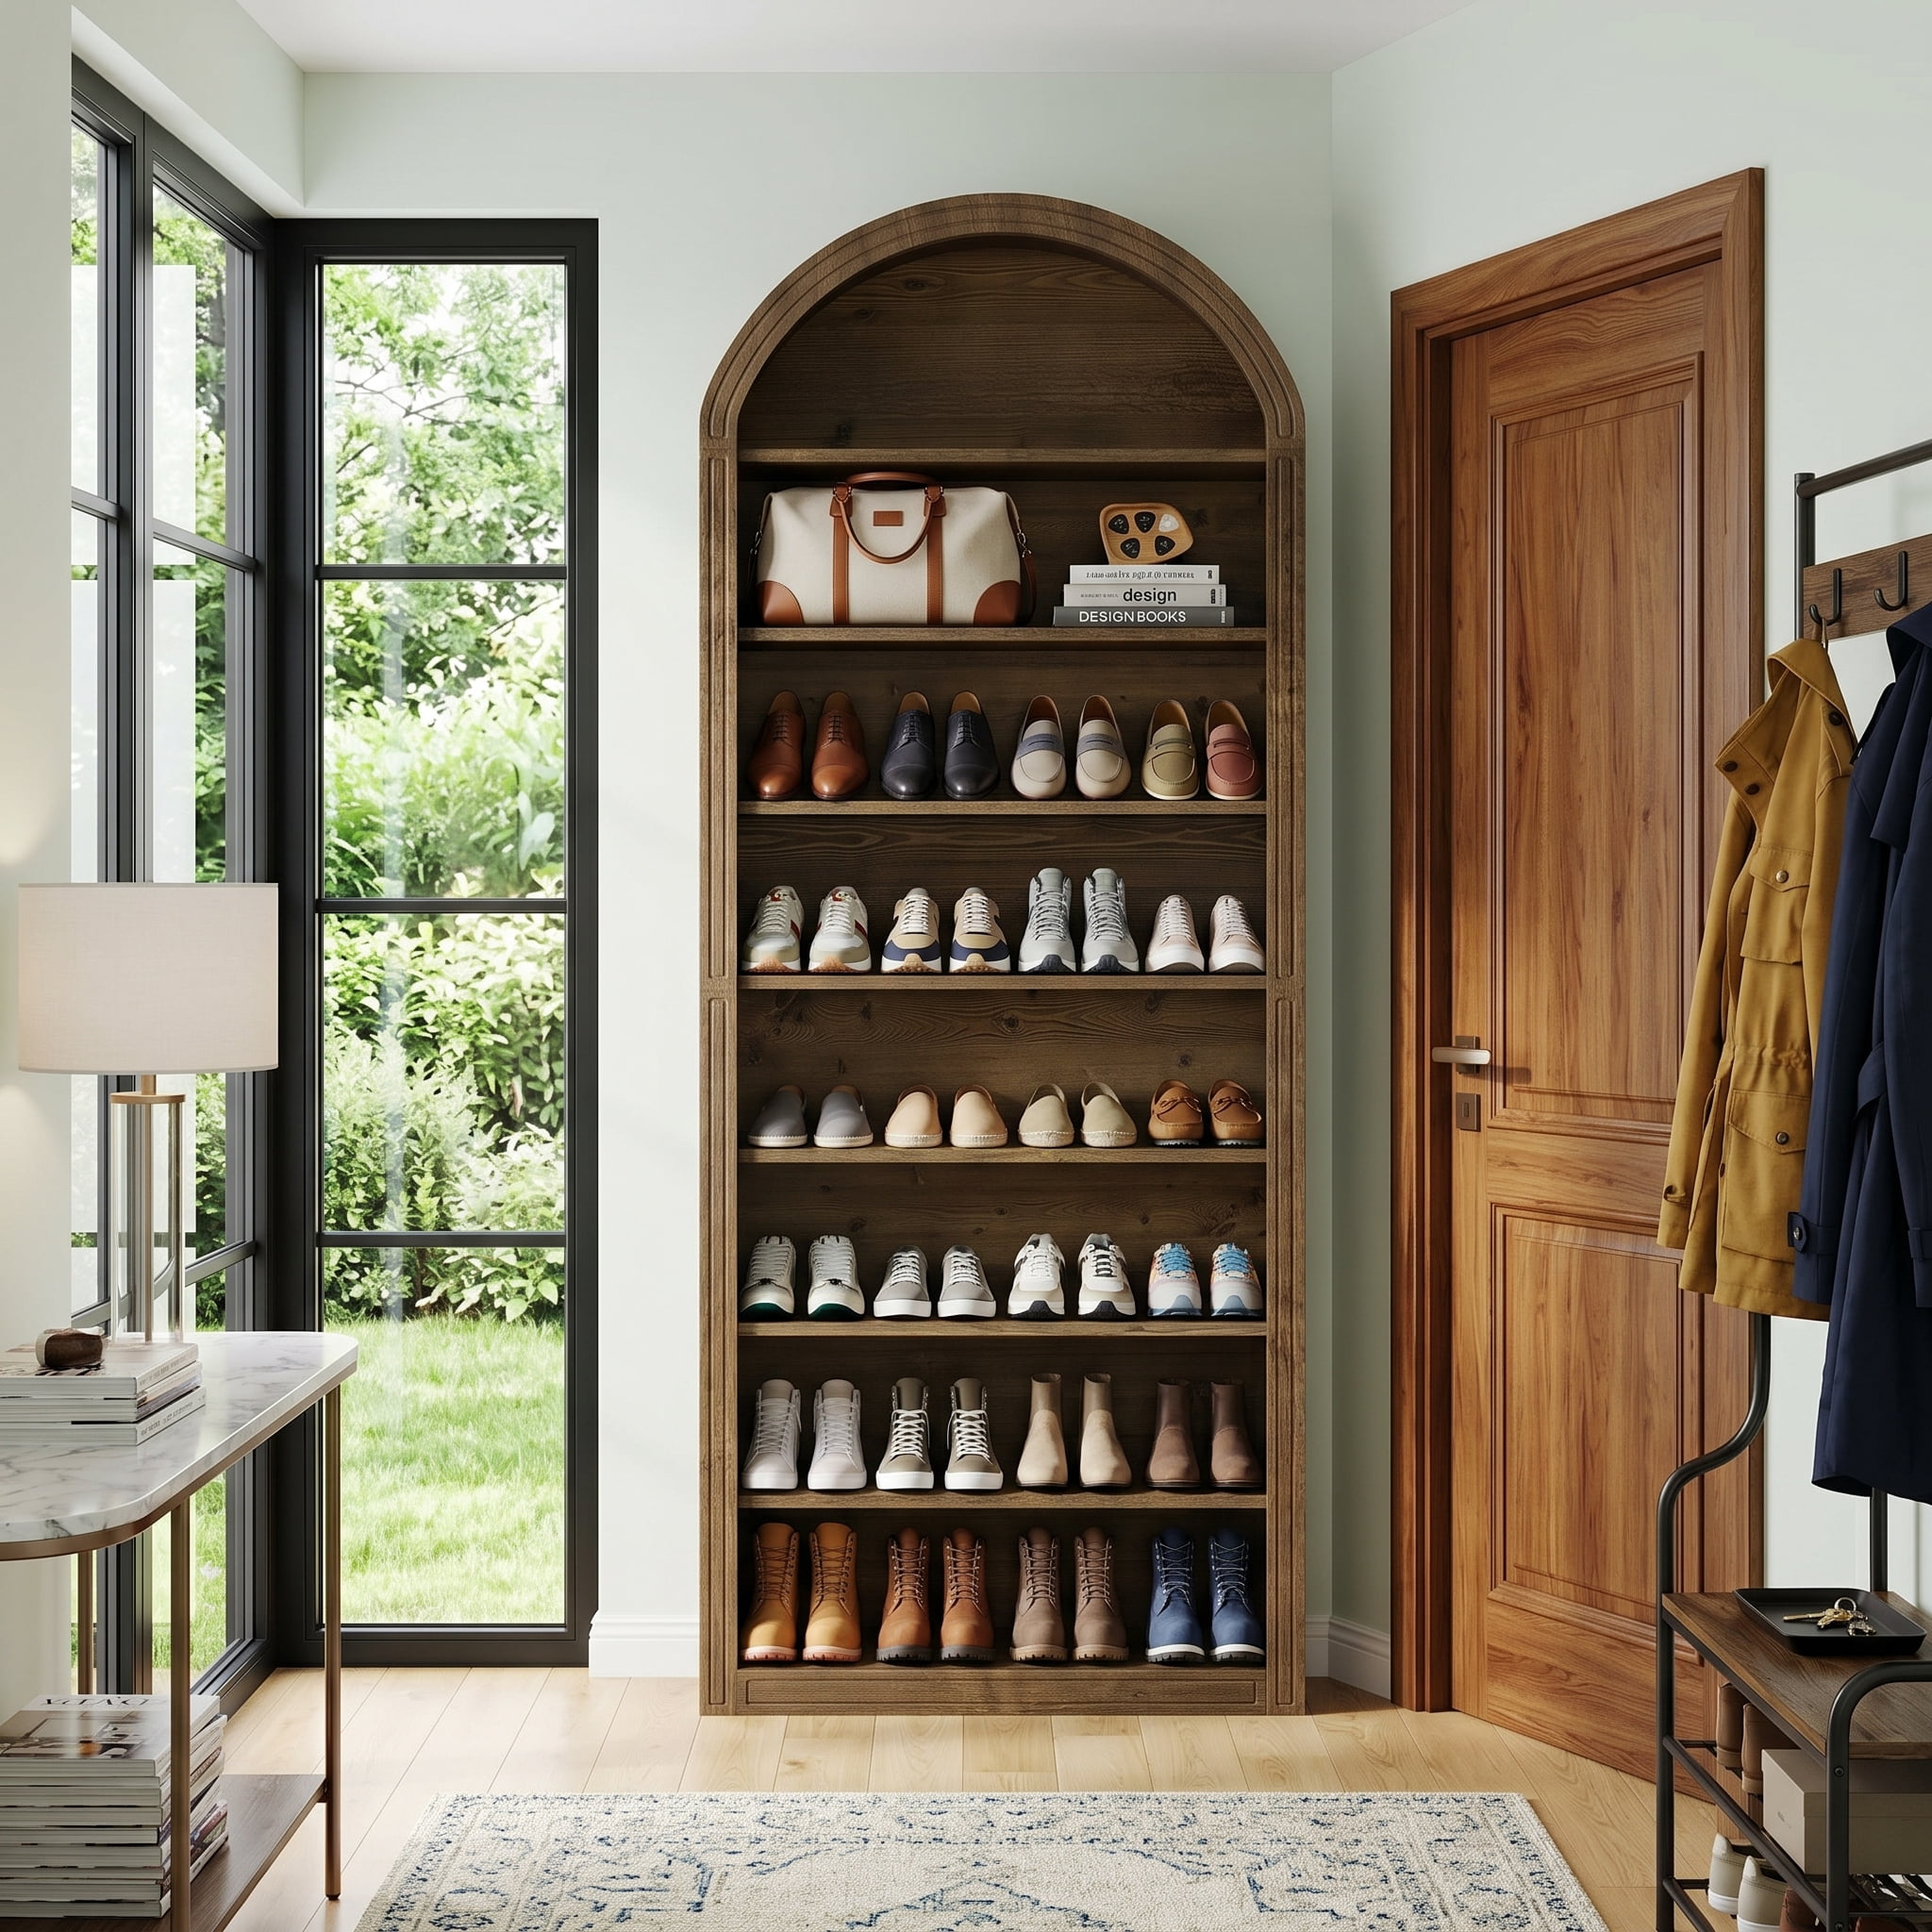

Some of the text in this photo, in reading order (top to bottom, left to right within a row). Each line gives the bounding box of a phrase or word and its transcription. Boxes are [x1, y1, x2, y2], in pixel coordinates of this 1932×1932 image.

[1123, 588, 1177, 605] design
[1079, 610, 1187, 623] DESIGN BOOKS
